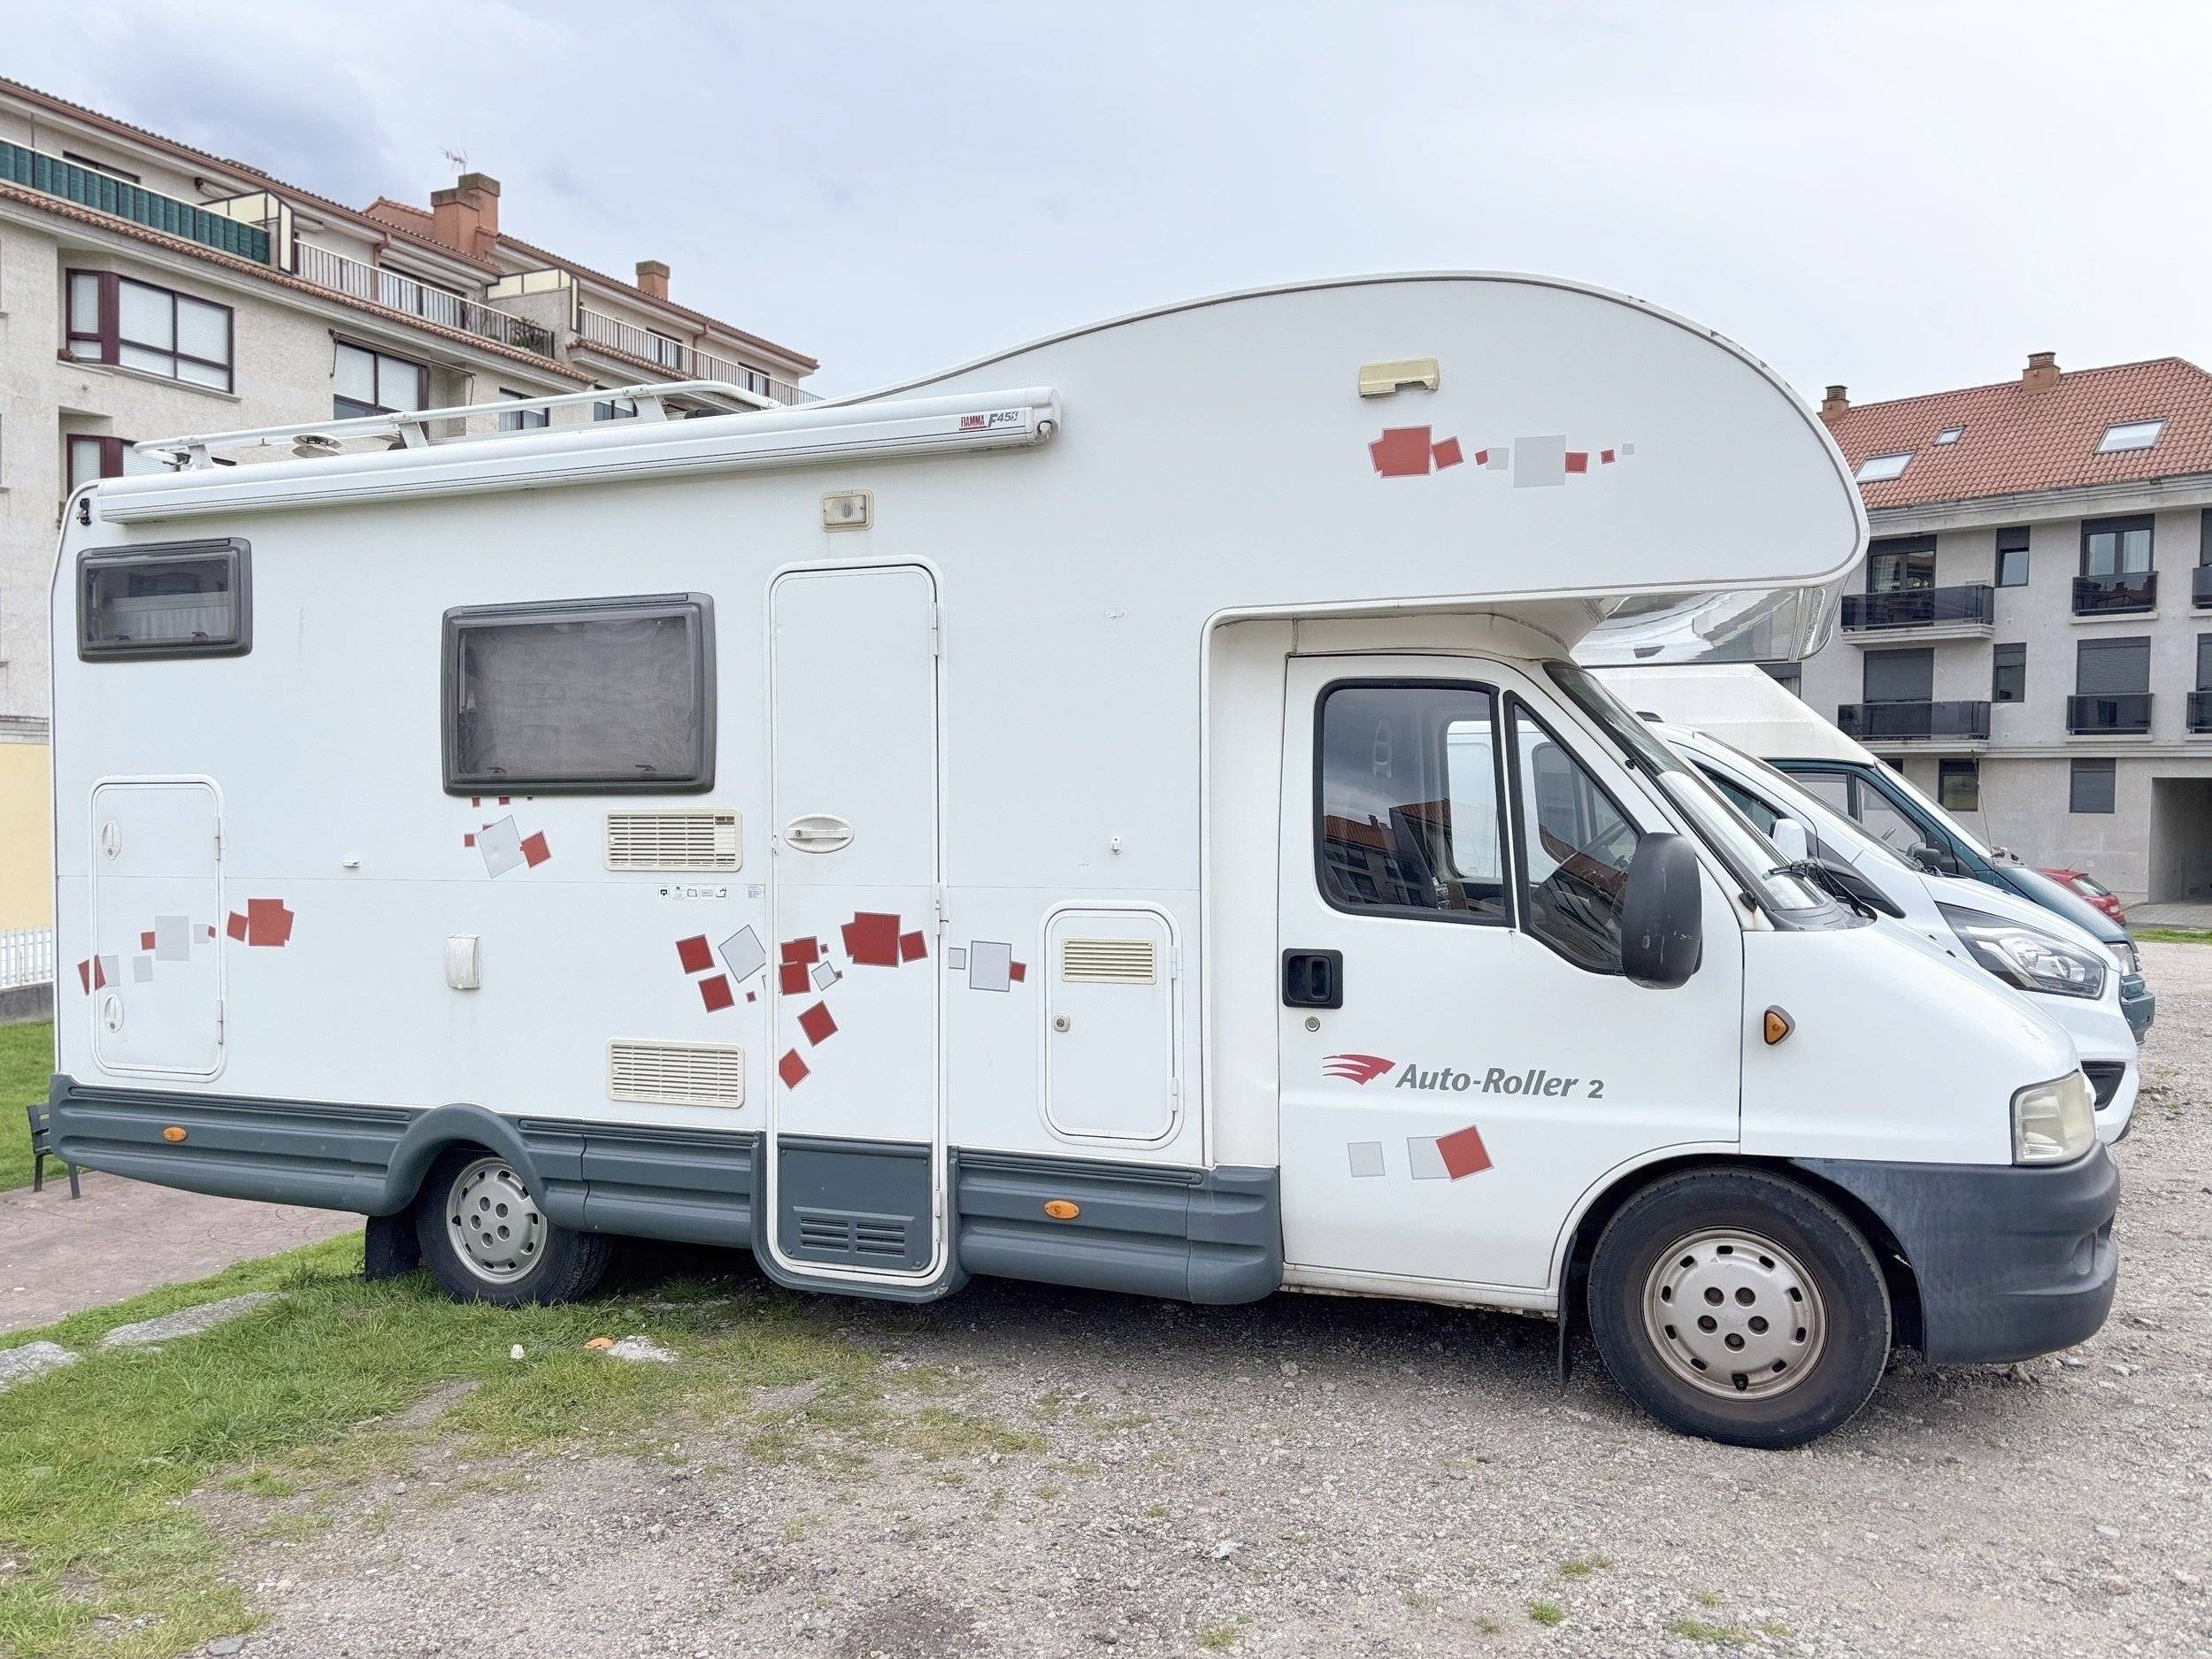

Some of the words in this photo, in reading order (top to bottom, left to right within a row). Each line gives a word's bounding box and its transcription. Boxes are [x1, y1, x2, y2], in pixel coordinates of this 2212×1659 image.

[960, 414, 985, 427] FIAMMA
[1394, 1064, 1578, 1097] Auto-Roller
[1587, 1079, 1604, 1099] 2
